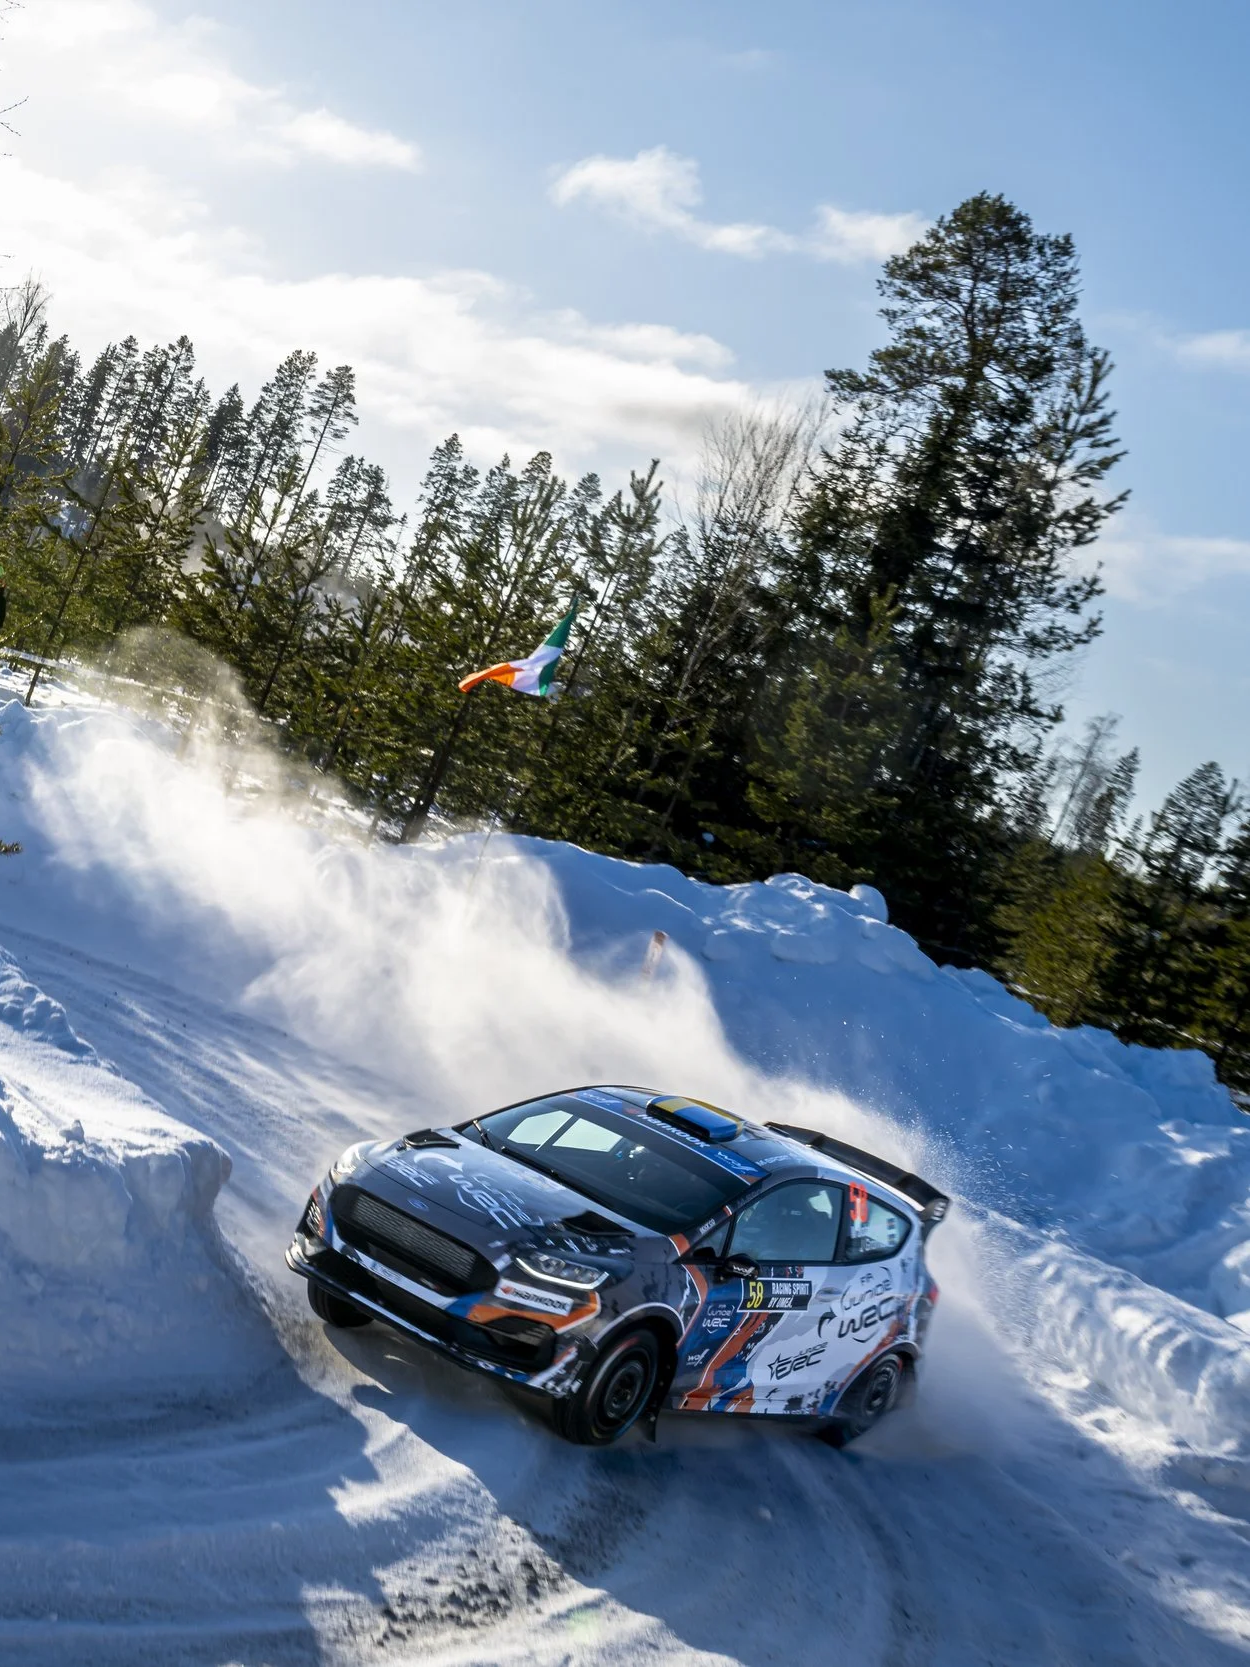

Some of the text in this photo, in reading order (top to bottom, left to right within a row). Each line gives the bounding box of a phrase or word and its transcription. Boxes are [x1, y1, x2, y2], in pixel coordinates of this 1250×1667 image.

[448, 1174, 522, 1230] WRC
[747, 1281, 764, 1308] 58
[771, 1282, 810, 1296] RACING SPIRIT
[767, 1297, 778, 1308] BY
[702, 1318, 730, 1327] WRC
[837, 1296, 897, 1338] WRC
